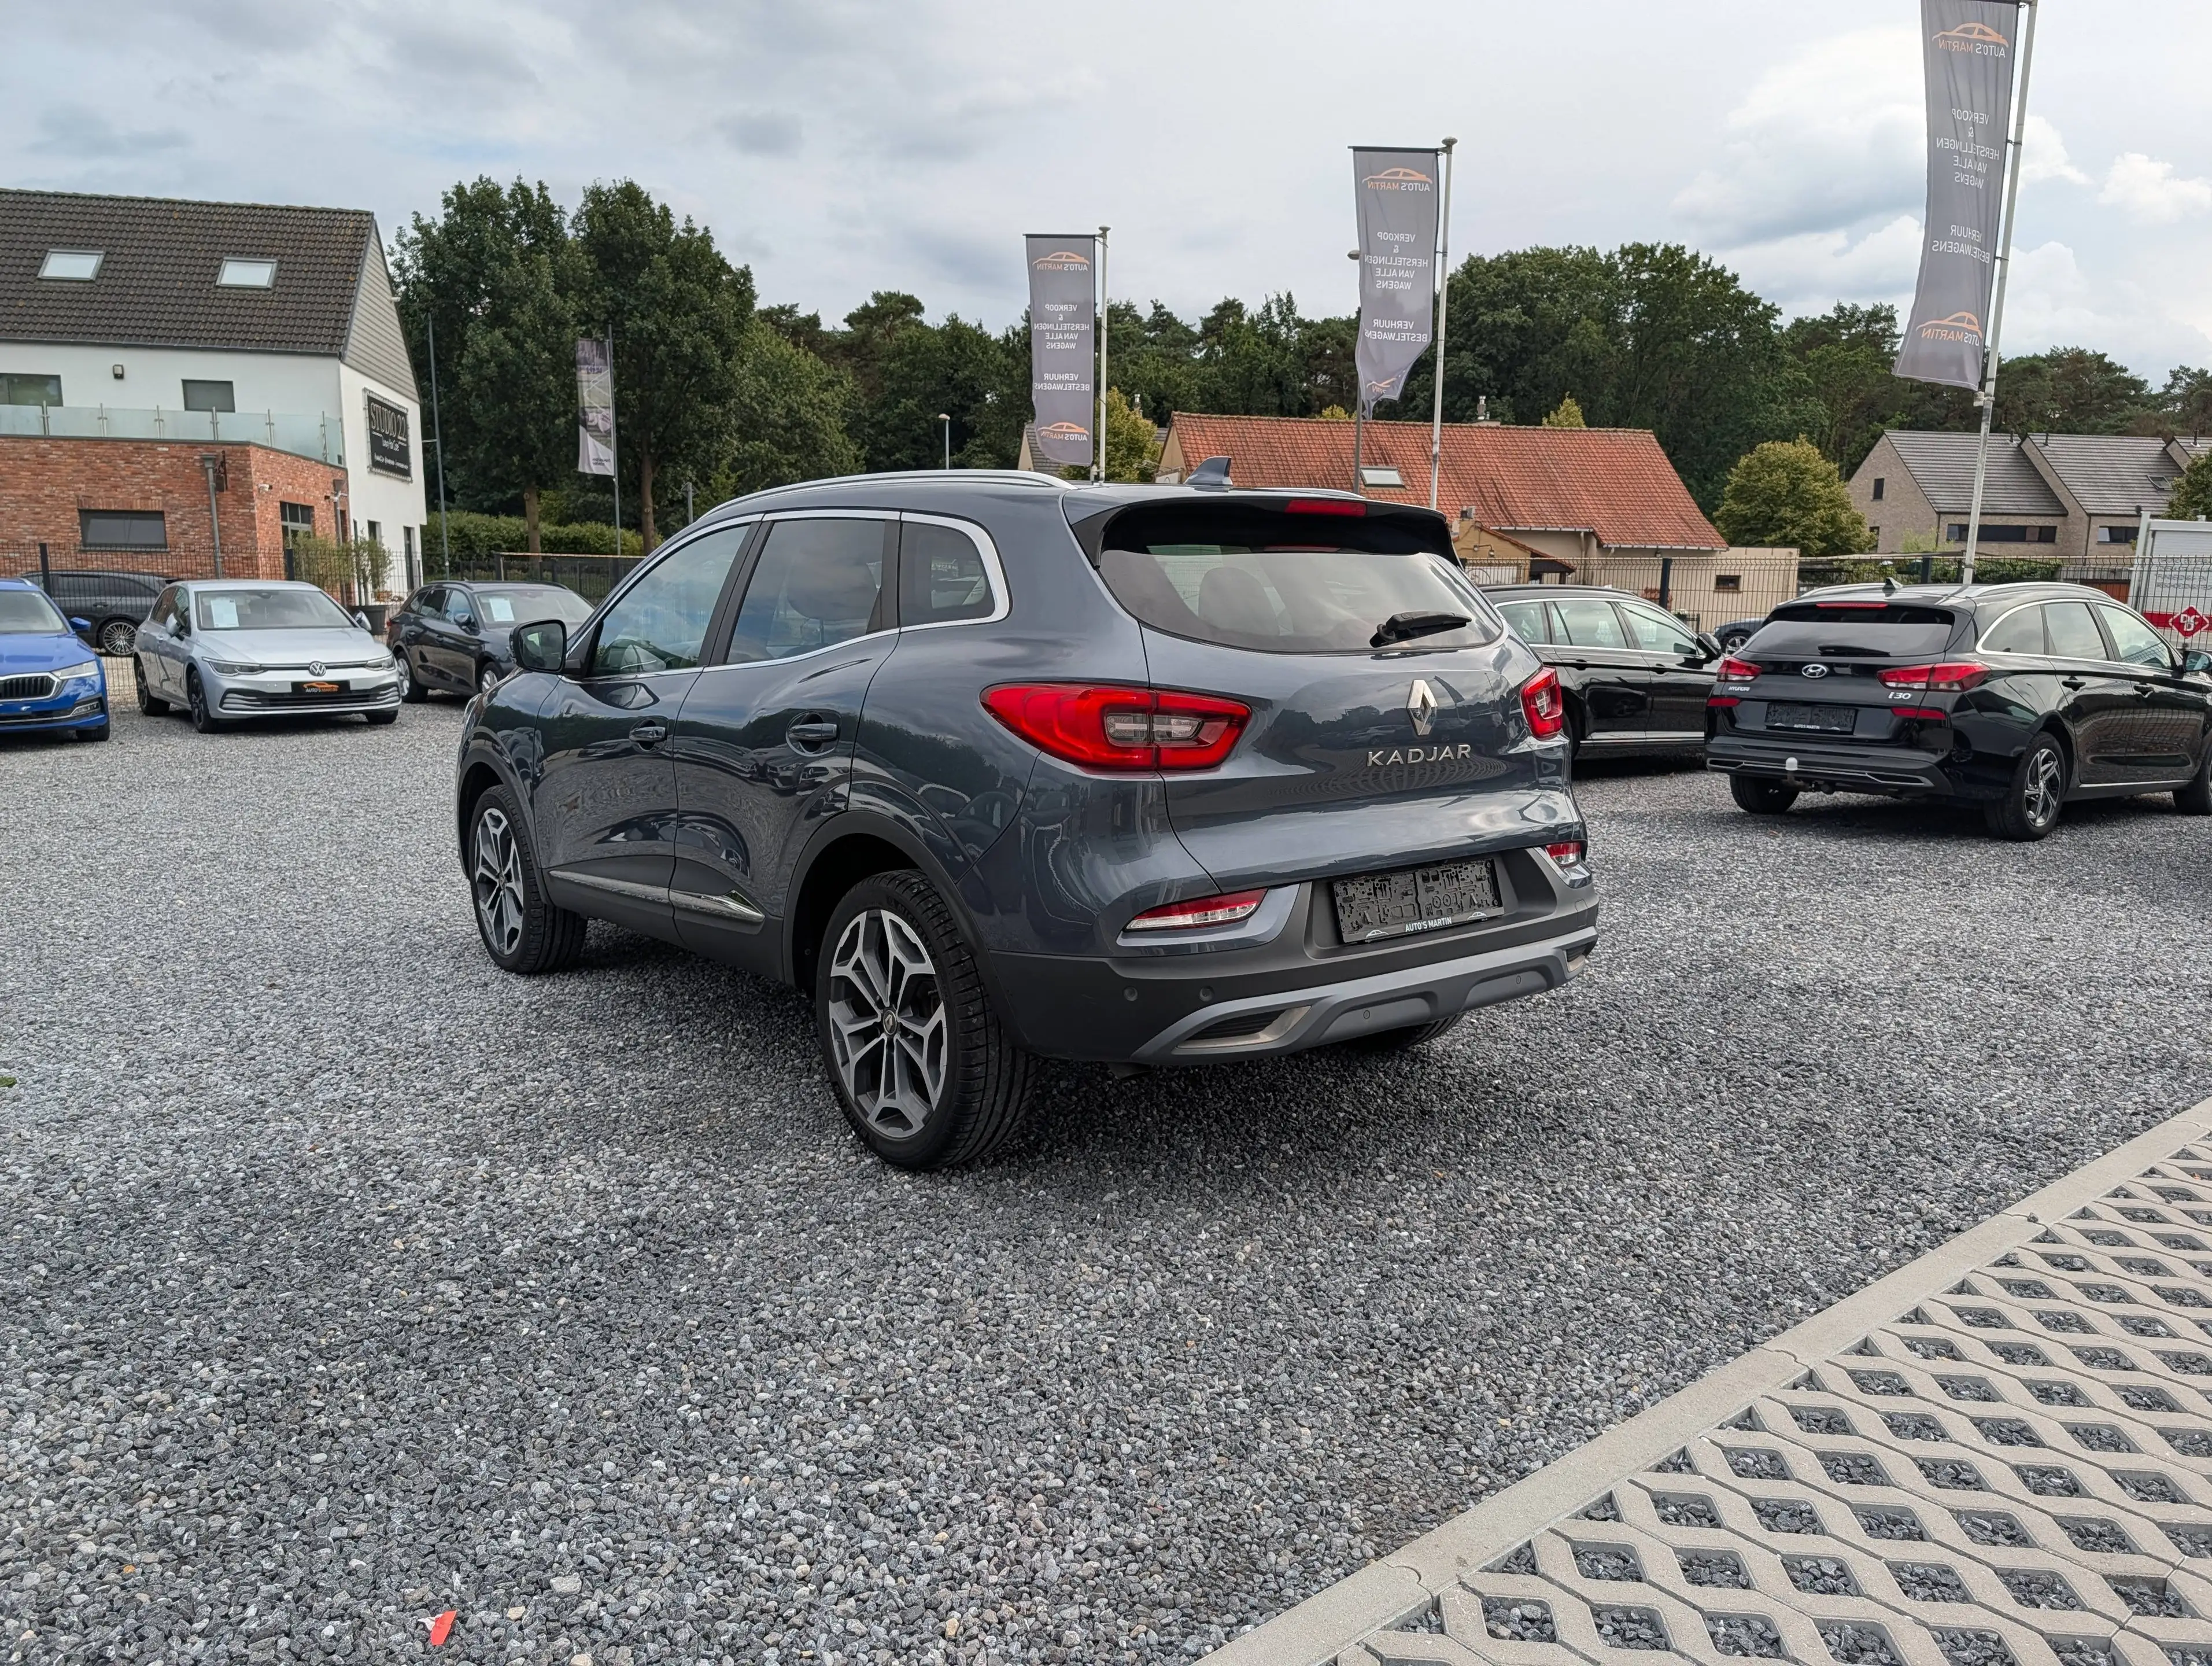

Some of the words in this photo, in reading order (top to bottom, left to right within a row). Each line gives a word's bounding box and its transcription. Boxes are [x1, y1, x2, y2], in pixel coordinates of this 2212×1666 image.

[370, 402, 397, 438] STUDIO
[397, 414, 407, 442] 22
[1367, 744, 1471, 767] KADJAR
[1405, 920, 1428, 932] AUTO'S
[1428, 916, 1452, 928] MARTIN
